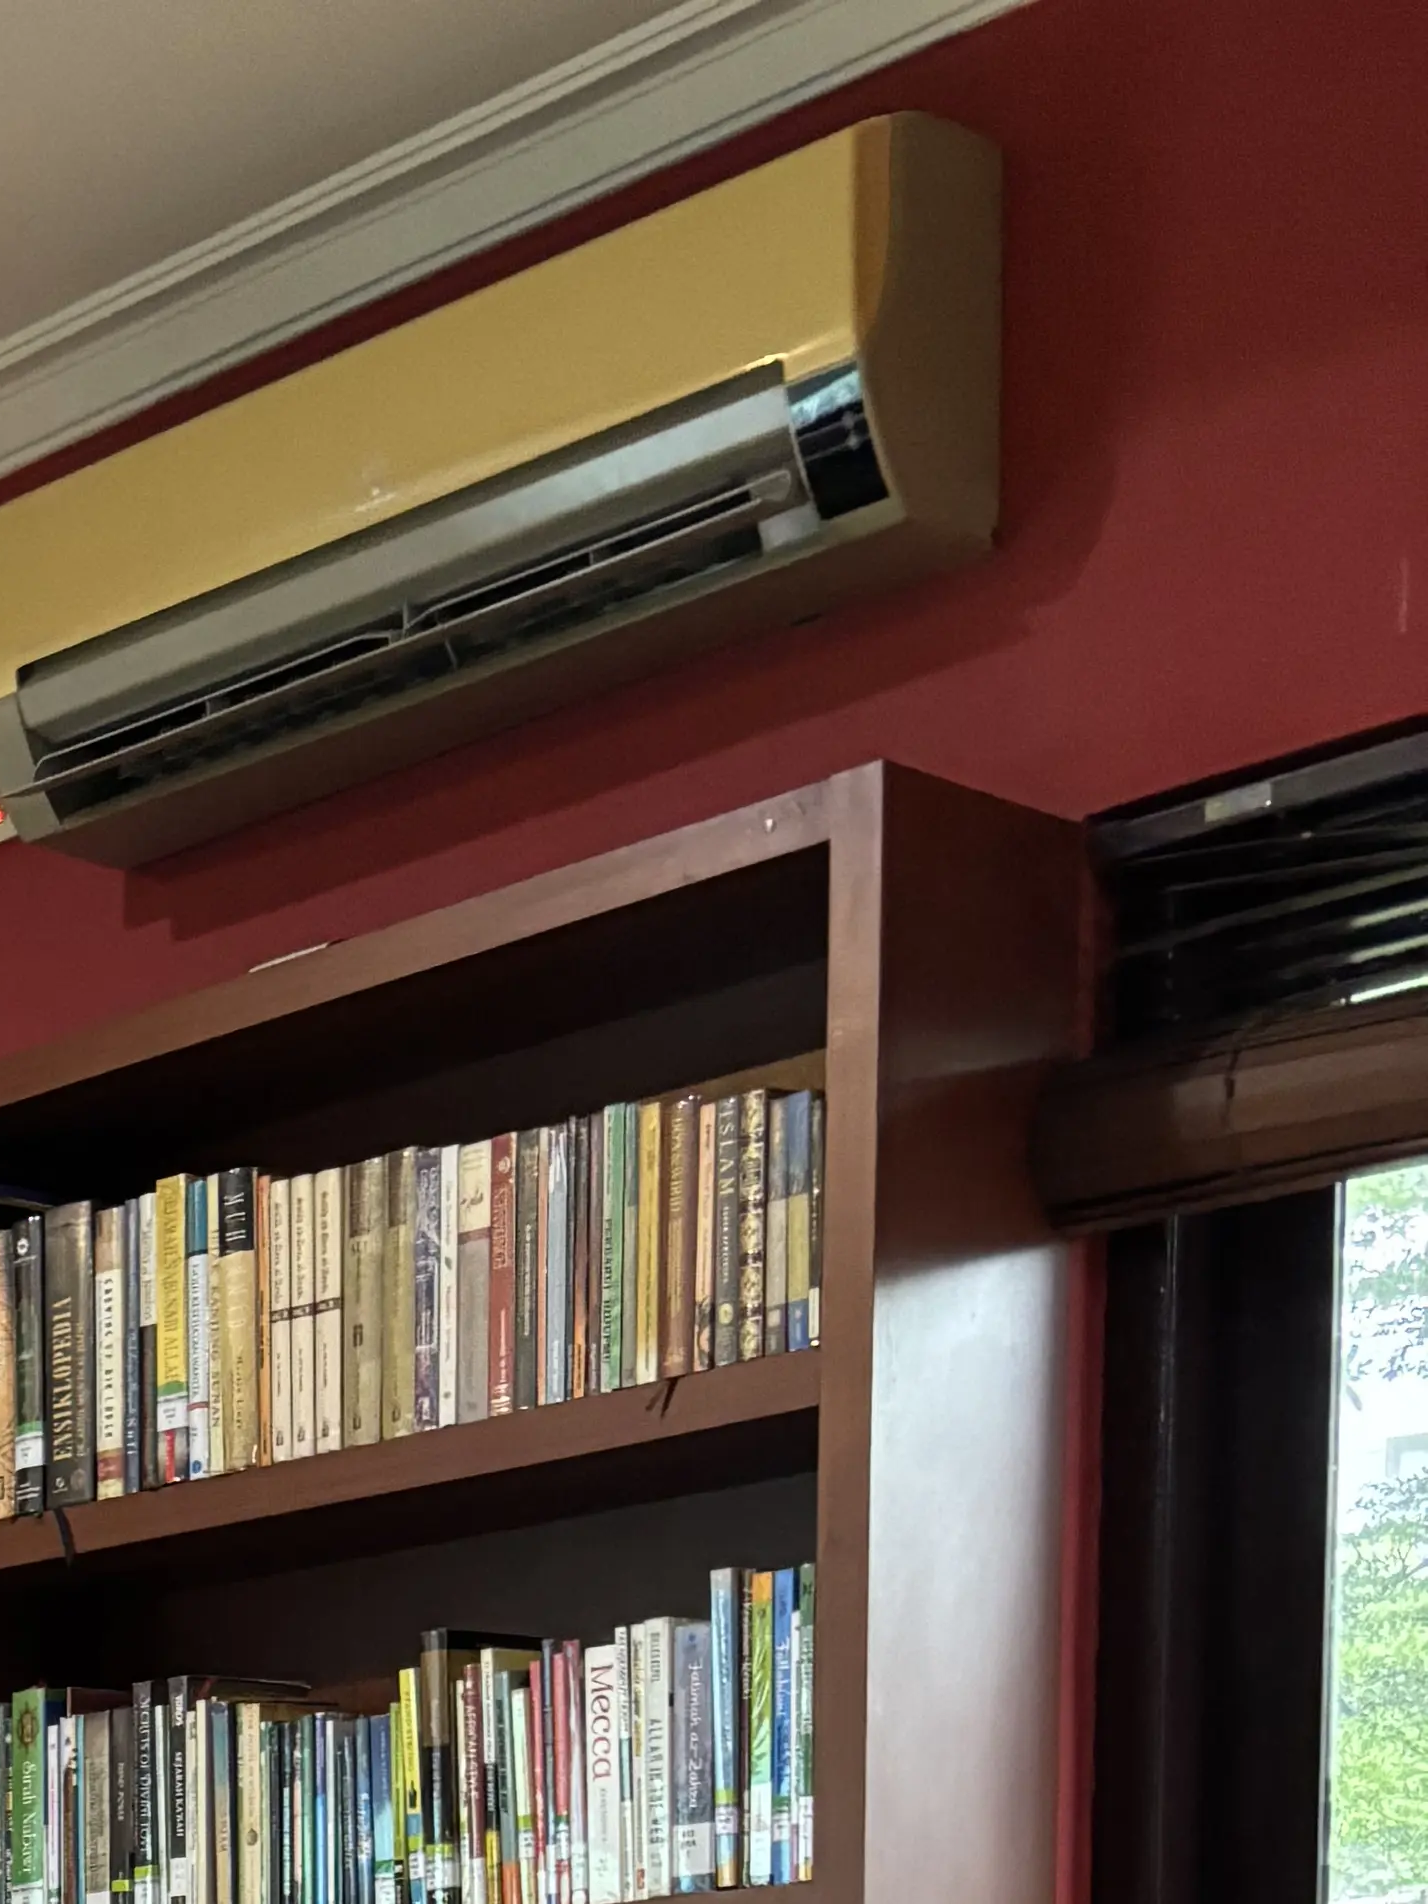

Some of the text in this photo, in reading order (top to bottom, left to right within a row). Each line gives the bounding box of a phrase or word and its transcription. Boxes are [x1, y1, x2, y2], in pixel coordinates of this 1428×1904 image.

[718, 1110, 735, 1198] ISLAM
[52, 1297, 72, 1462] ENSIKLOPEDIA
[173, 1751, 184, 1797] SEJARAH
[590, 1664, 615, 1782] Mecca
[687, 1662, 705, 1809] Fatimah az-Zahra
[18, 1761, 38, 1875] Sirah Nabawi
